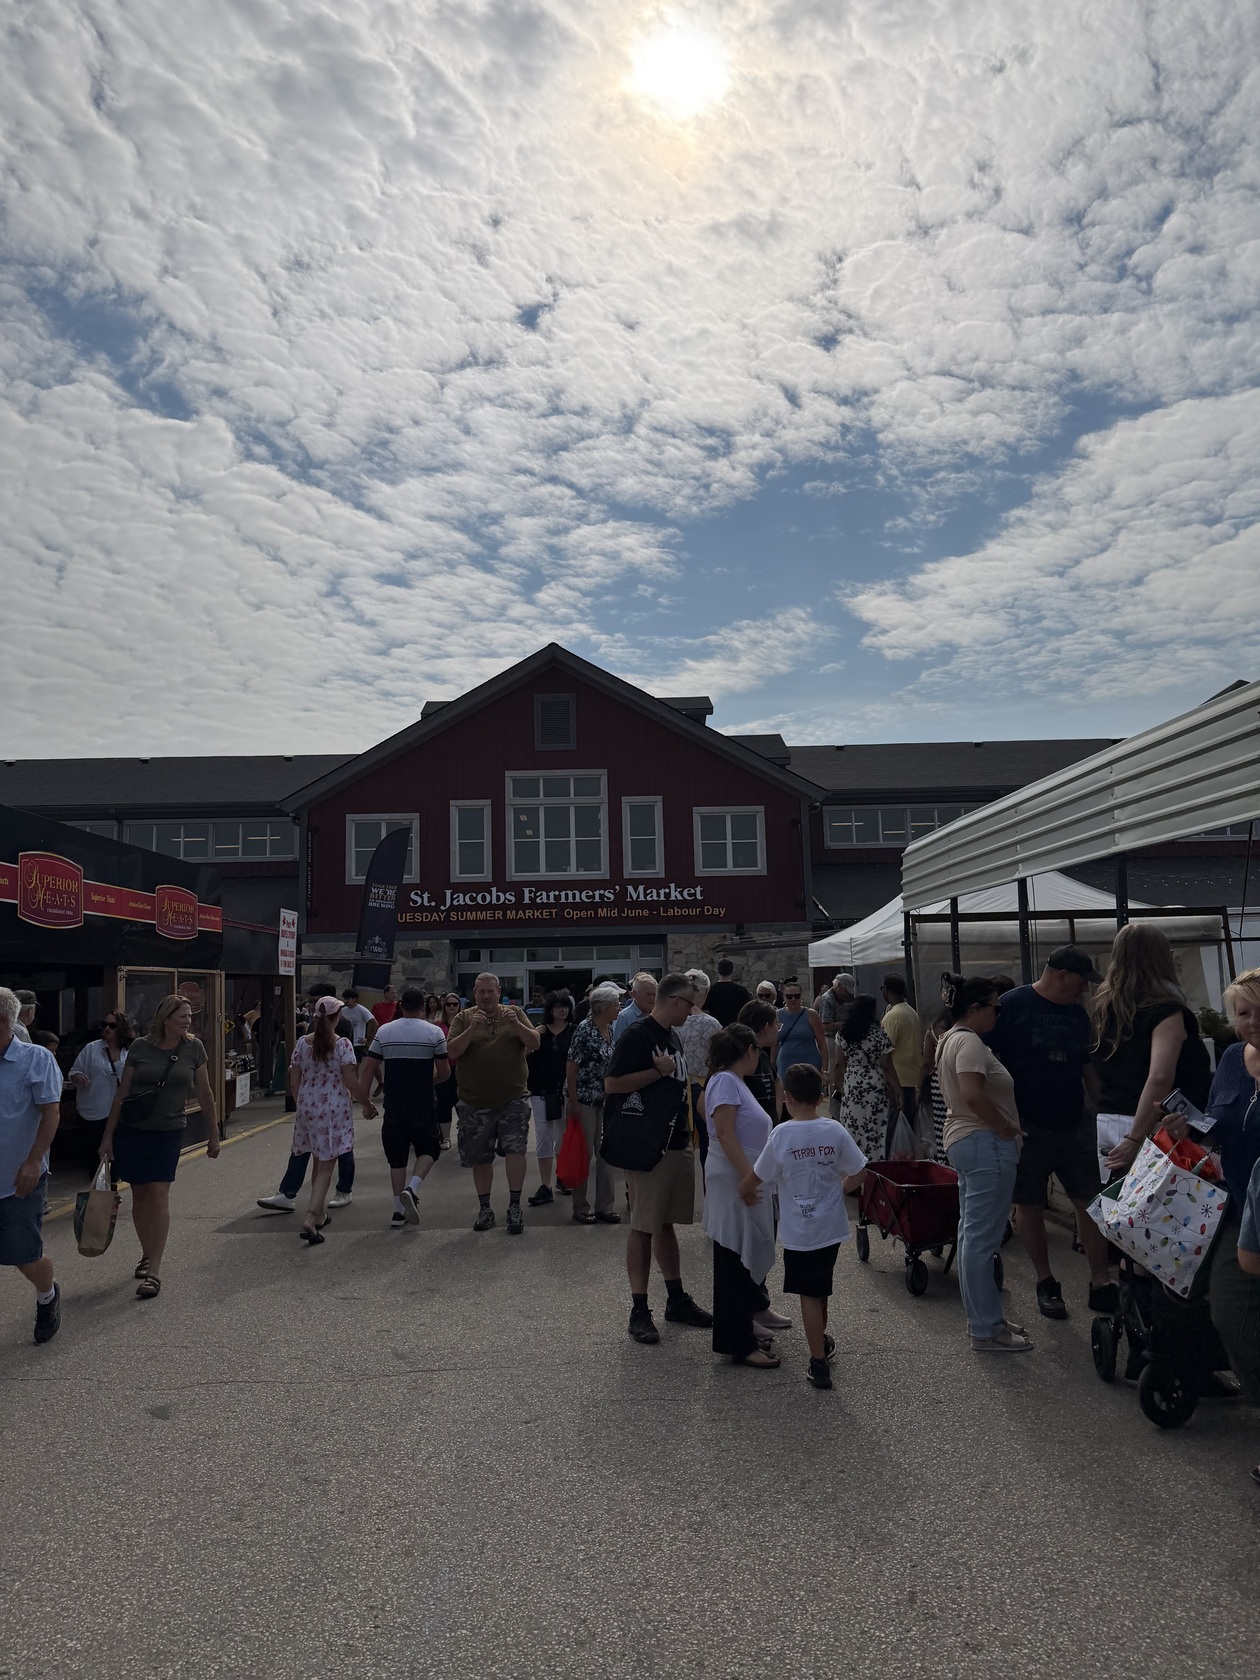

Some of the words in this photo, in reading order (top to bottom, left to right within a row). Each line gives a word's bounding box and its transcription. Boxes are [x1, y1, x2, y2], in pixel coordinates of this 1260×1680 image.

[24, 860, 79, 893] SUPERIOR
[369, 893, 396, 901] BITTER
[371, 887, 397, 896] WE'RE
[409, 889, 436, 907] St.
[440, 886, 516, 910] Jacobs
[626, 882, 704, 901] Market
[161, 892, 195, 913] SUPERIOR
[368, 901, 395, 909] BREWING
[397, 912, 446, 923] UESDAY
[449, 910, 503, 921] SUMMER
[506, 909, 558, 920] MARKET
[564, 908, 595, 920] Open
[598, 907, 618, 917] Mid
[621, 907, 650, 917] June
[660, 906, 701, 916] Labour
[704, 906, 726, 917] Day
[791, 1147, 816, 1160] TERRY
[818, 1145, 836, 1156] FOX
